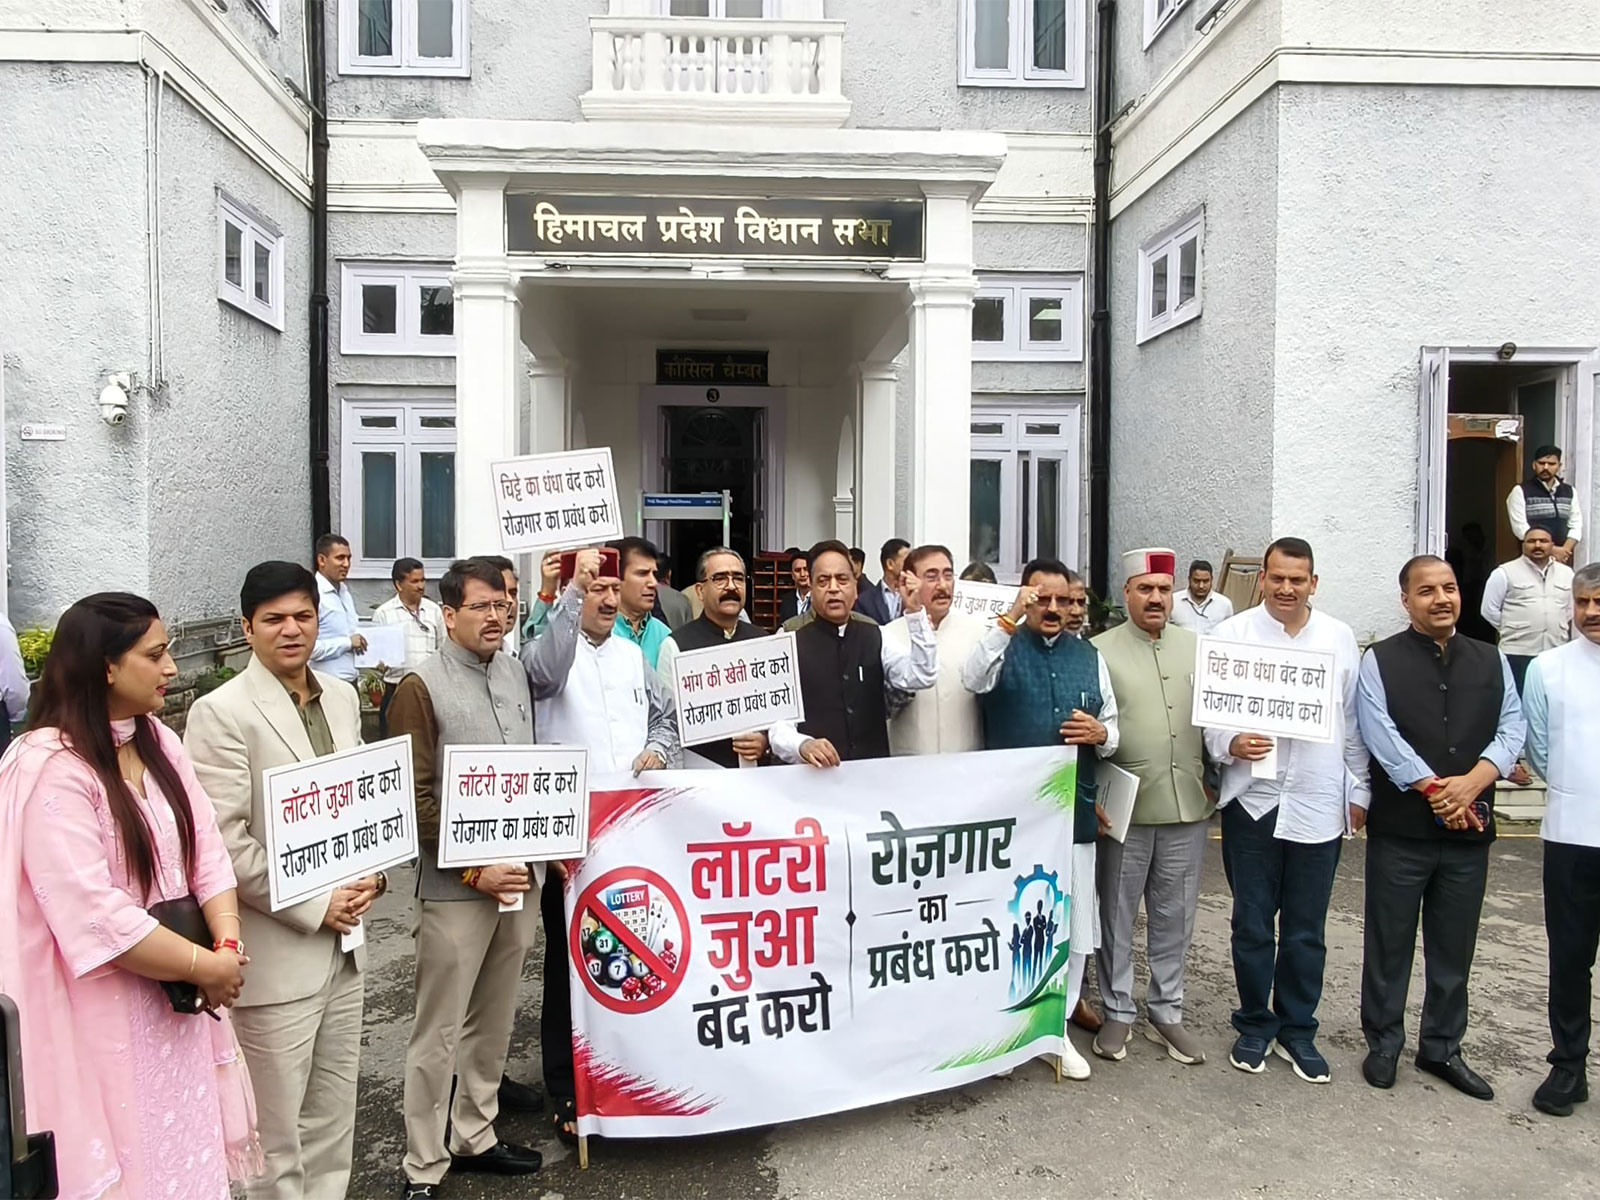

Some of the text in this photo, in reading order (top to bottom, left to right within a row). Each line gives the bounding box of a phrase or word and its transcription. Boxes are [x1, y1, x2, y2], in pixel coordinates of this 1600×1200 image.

[533, 201, 892, 246] हिमाचल प्रदेश विधान सभा
[500, 472, 523, 501] चिट्टे
[524, 476, 540, 496] का
[542, 470, 564, 494] धंधा
[583, 463, 605, 489] करो
[544, 510, 560, 530] का
[965, 596, 988, 615] जुआ
[681, 651, 790, 693] भांग की खेती बंद करो
[1207, 650, 1229, 680] चिट्टे
[1232, 659, 1250, 680] का
[1253, 657, 1276, 683] धंधा
[1301, 663, 1326, 689] करो
[725, 697, 741, 717] का
[743, 689, 767, 713] प्रबंध
[1247, 695, 1265, 717] का
[1266, 695, 1295, 720] प्रबंध
[281, 760, 402, 824] लॉटरी जुआ बंद करो
[458, 764, 578, 803] लॉटरी जुआ बंद करो
[331, 832, 349, 861] का
[352, 819, 378, 854] प्रबंध
[502, 818, 519, 841] का
[522, 810, 549, 839] प्रबंध
[686, 816, 830, 900] लॉटरी
[866, 810, 1017, 890] रोज़गार
[610, 889, 645, 905] LOTTERY
[918, 894, 948, 924] का
[582, 927, 591, 938] 17
[599, 938, 609, 949] 31
[701, 906, 819, 992] जुआ
[591, 963, 600, 973] 17
[614, 965, 621, 976] 7
[867, 917, 1001, 989] प्रबंध करो
[692, 971, 833, 1050] बंद करो
